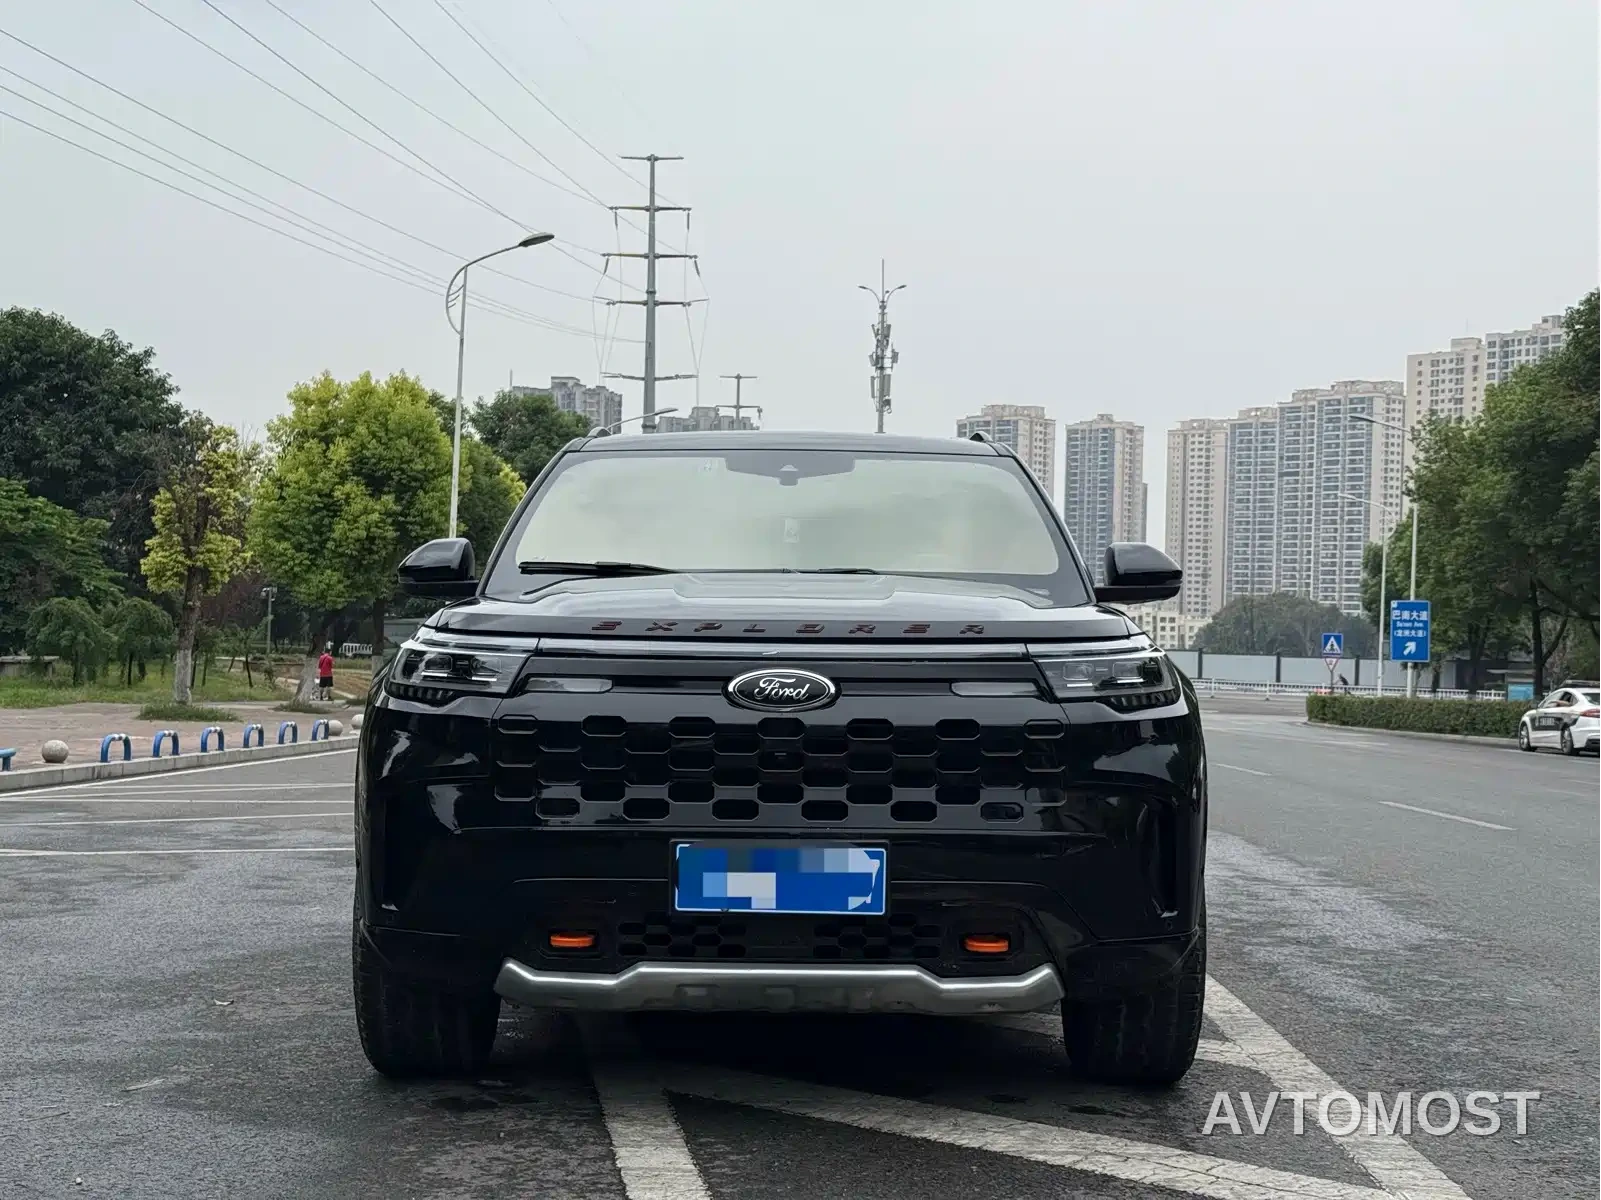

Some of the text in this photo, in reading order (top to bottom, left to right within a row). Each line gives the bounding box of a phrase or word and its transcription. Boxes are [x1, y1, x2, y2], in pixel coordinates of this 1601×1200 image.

[1392, 609, 1428, 621] 巴南大道
[591, 620, 986, 635] EXPLORER
[753, 677, 811, 702] Ford
